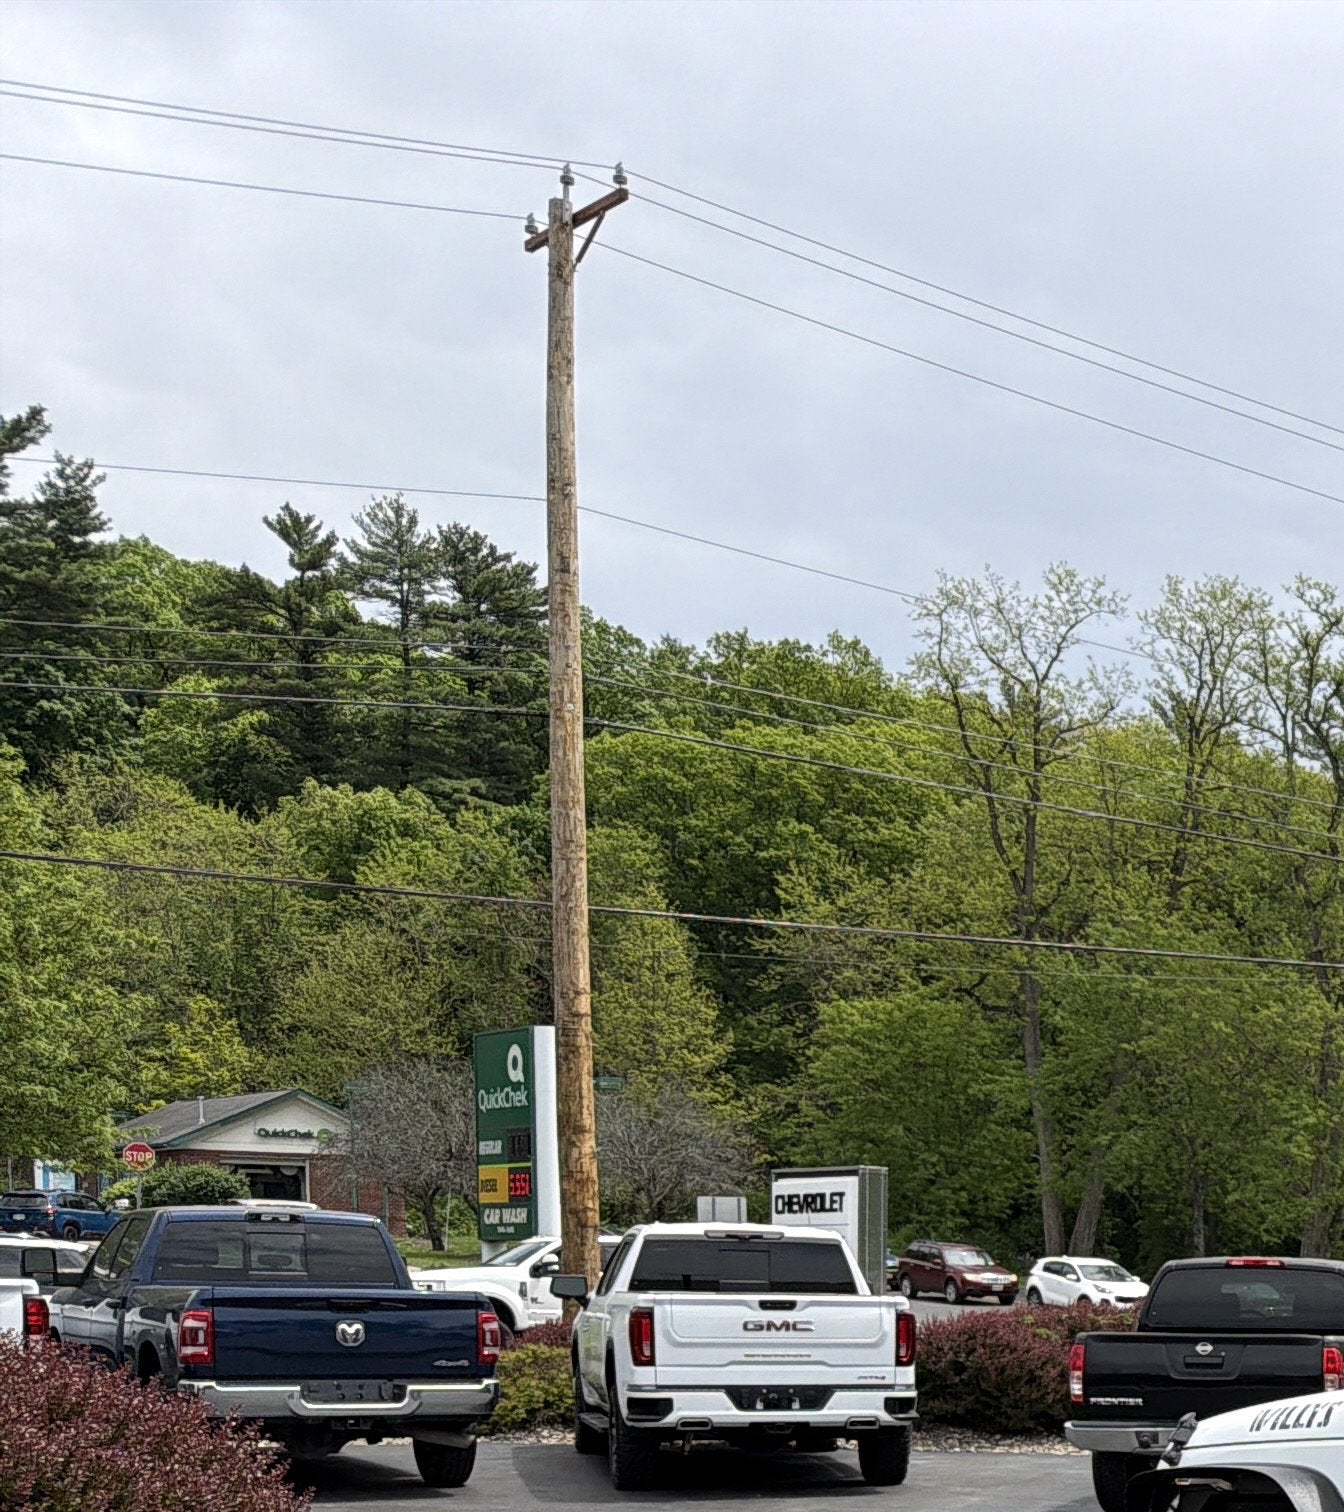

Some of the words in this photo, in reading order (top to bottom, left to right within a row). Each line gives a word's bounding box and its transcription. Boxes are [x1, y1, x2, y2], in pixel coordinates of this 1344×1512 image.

[478, 1085, 529, 1113] QuickChek
[125, 1151, 152, 1163] STOP
[774, 1191, 846, 1215] CHEVROLET
[483, 1208, 501, 1225] CAR
[502, 1207, 528, 1224] WASH
[742, 1319, 816, 1333] GMC
[1089, 1397, 1143, 1406] FRONTIER
[1249, 1400, 1344, 1433] WILLYS
